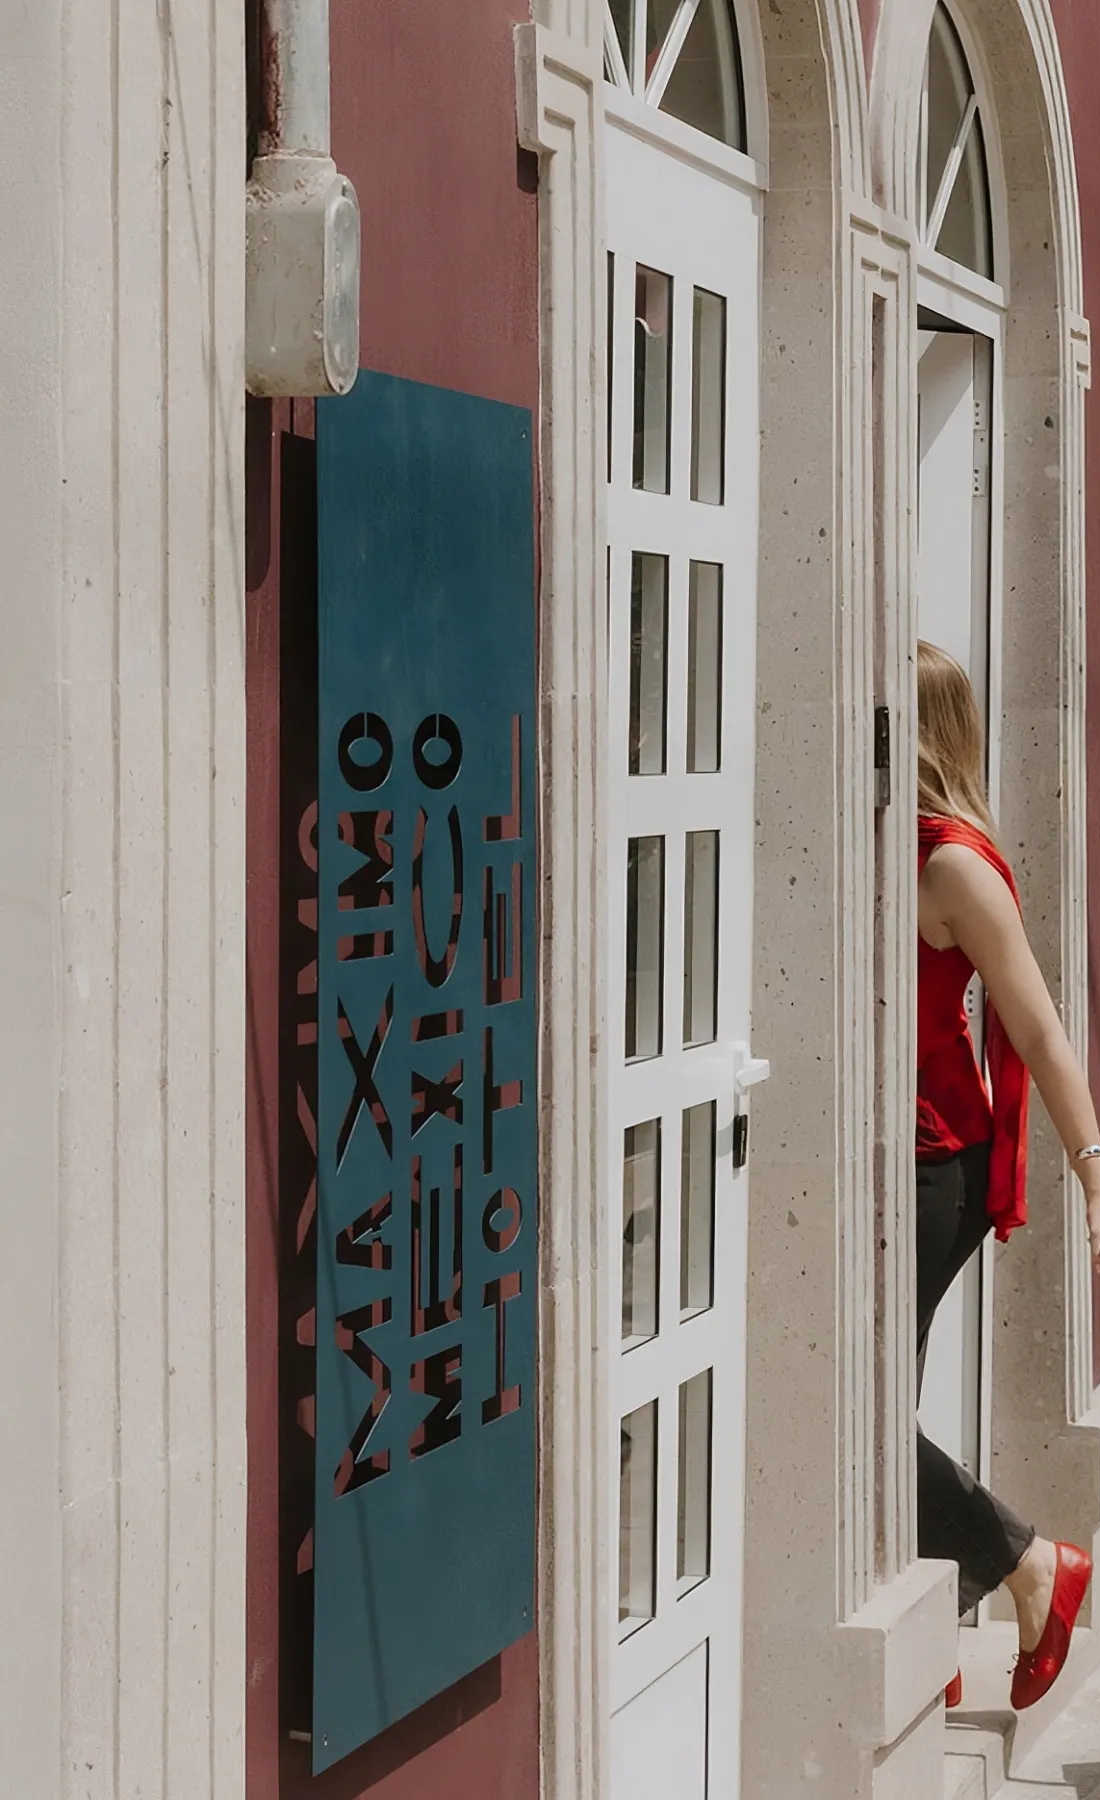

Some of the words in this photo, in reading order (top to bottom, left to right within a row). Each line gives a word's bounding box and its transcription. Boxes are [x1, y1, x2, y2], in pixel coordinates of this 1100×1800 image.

[335, 711, 394, 1500] MAXIMO
[410, 712, 463, 1461] MEXICO
[482, 714, 523, 1427] HOTEL
